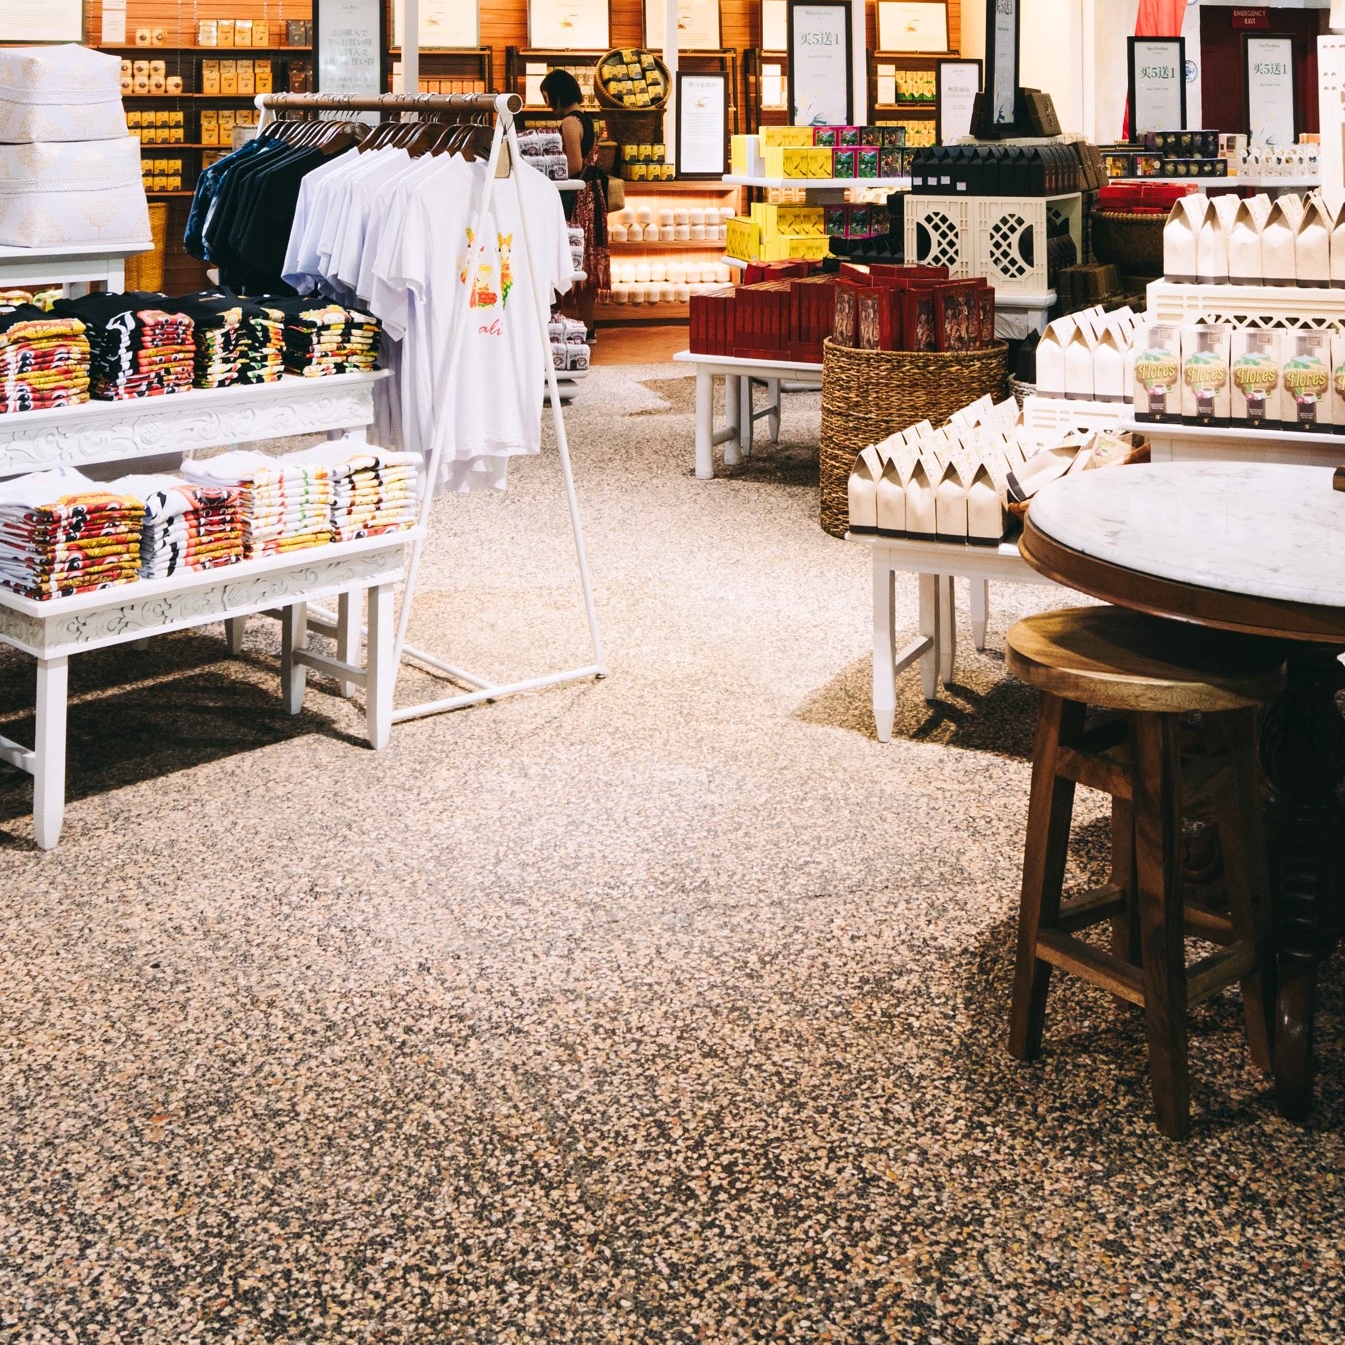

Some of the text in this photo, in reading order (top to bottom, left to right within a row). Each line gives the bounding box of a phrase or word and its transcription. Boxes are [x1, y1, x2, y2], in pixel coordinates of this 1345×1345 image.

[800, 32, 839, 46] 买5送1
[1140, 66, 1176, 79] 买5送1
[1253, 62, 1287, 75] 买5送1
[478, 318, 503, 336] ali
